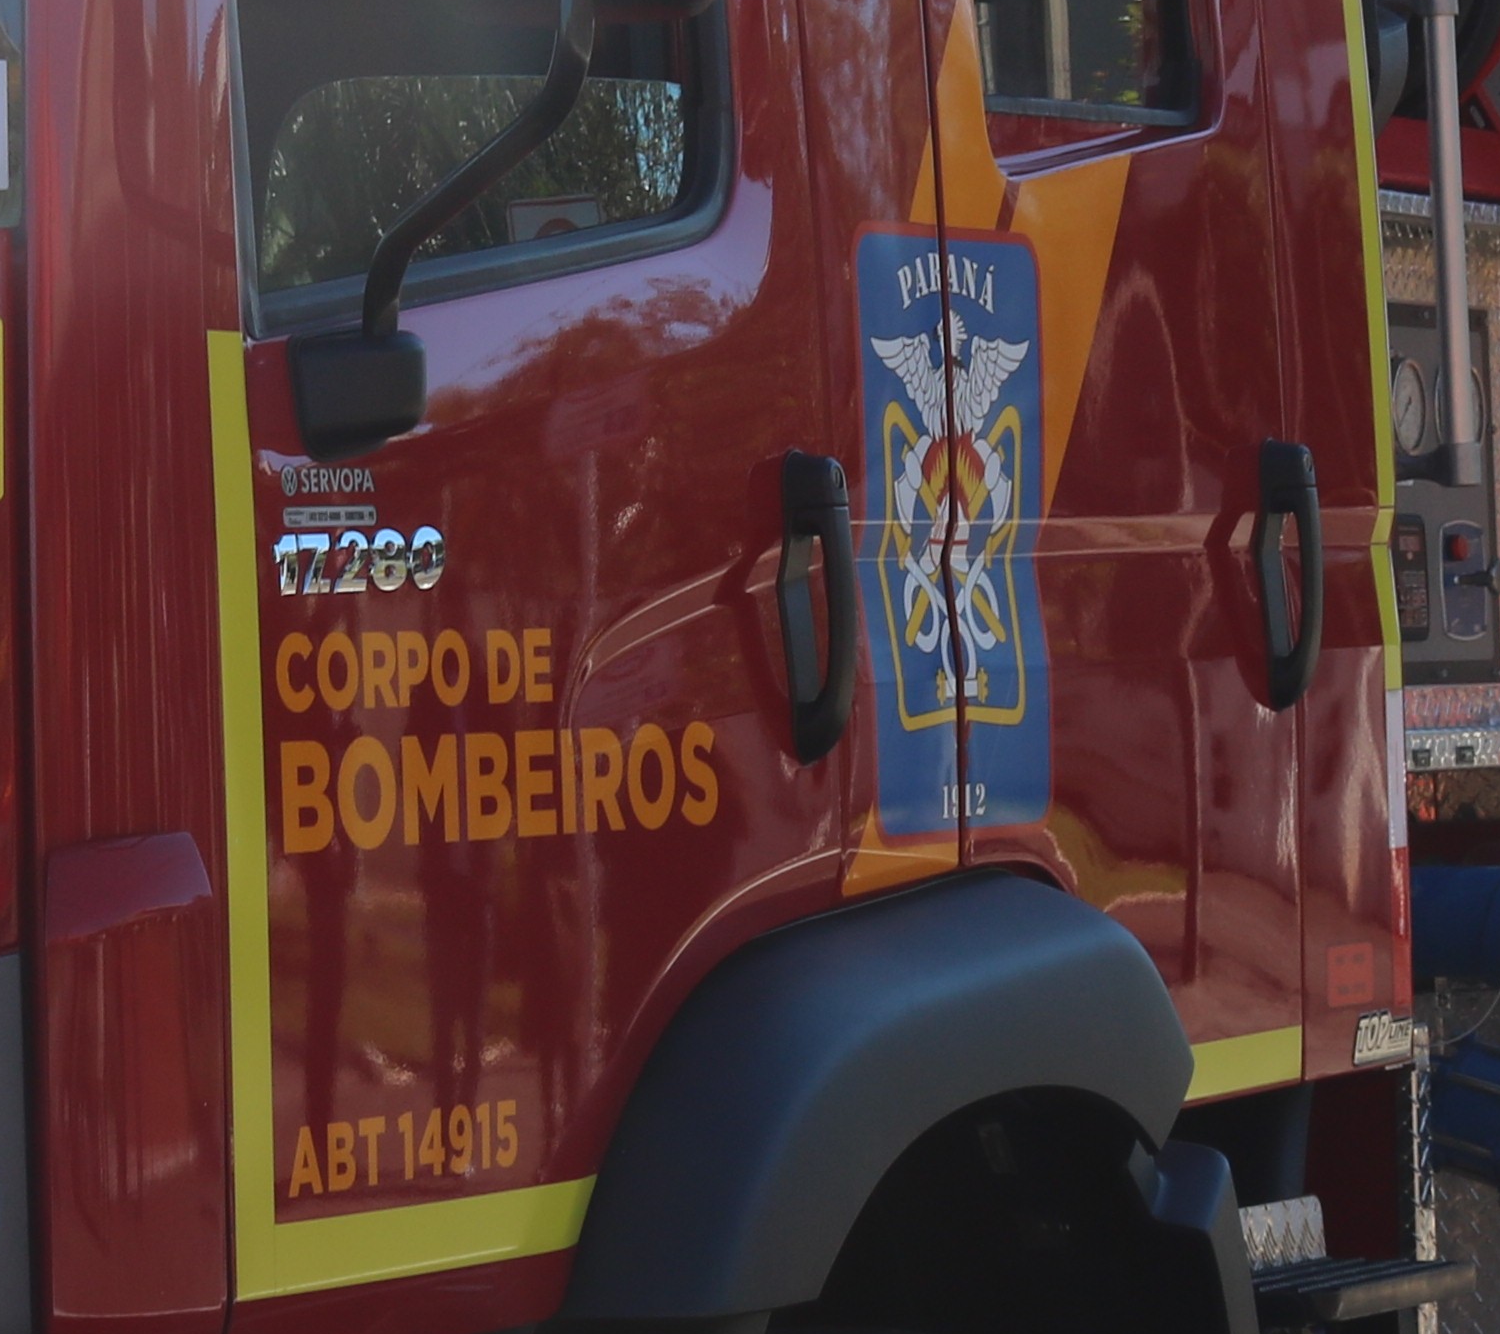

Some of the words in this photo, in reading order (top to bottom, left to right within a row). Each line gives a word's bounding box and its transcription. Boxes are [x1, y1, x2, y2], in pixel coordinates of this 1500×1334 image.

[896, 251, 996, 315] PARANÁ
[301, 468, 375, 493] SERVOPA
[275, 628, 471, 714] CORPO
[486, 627, 554, 705] DE
[280, 720, 719, 855] BOMBEIROS
[288, 1115, 386, 1199] ABT
[398, 1099, 519, 1181] 14915
